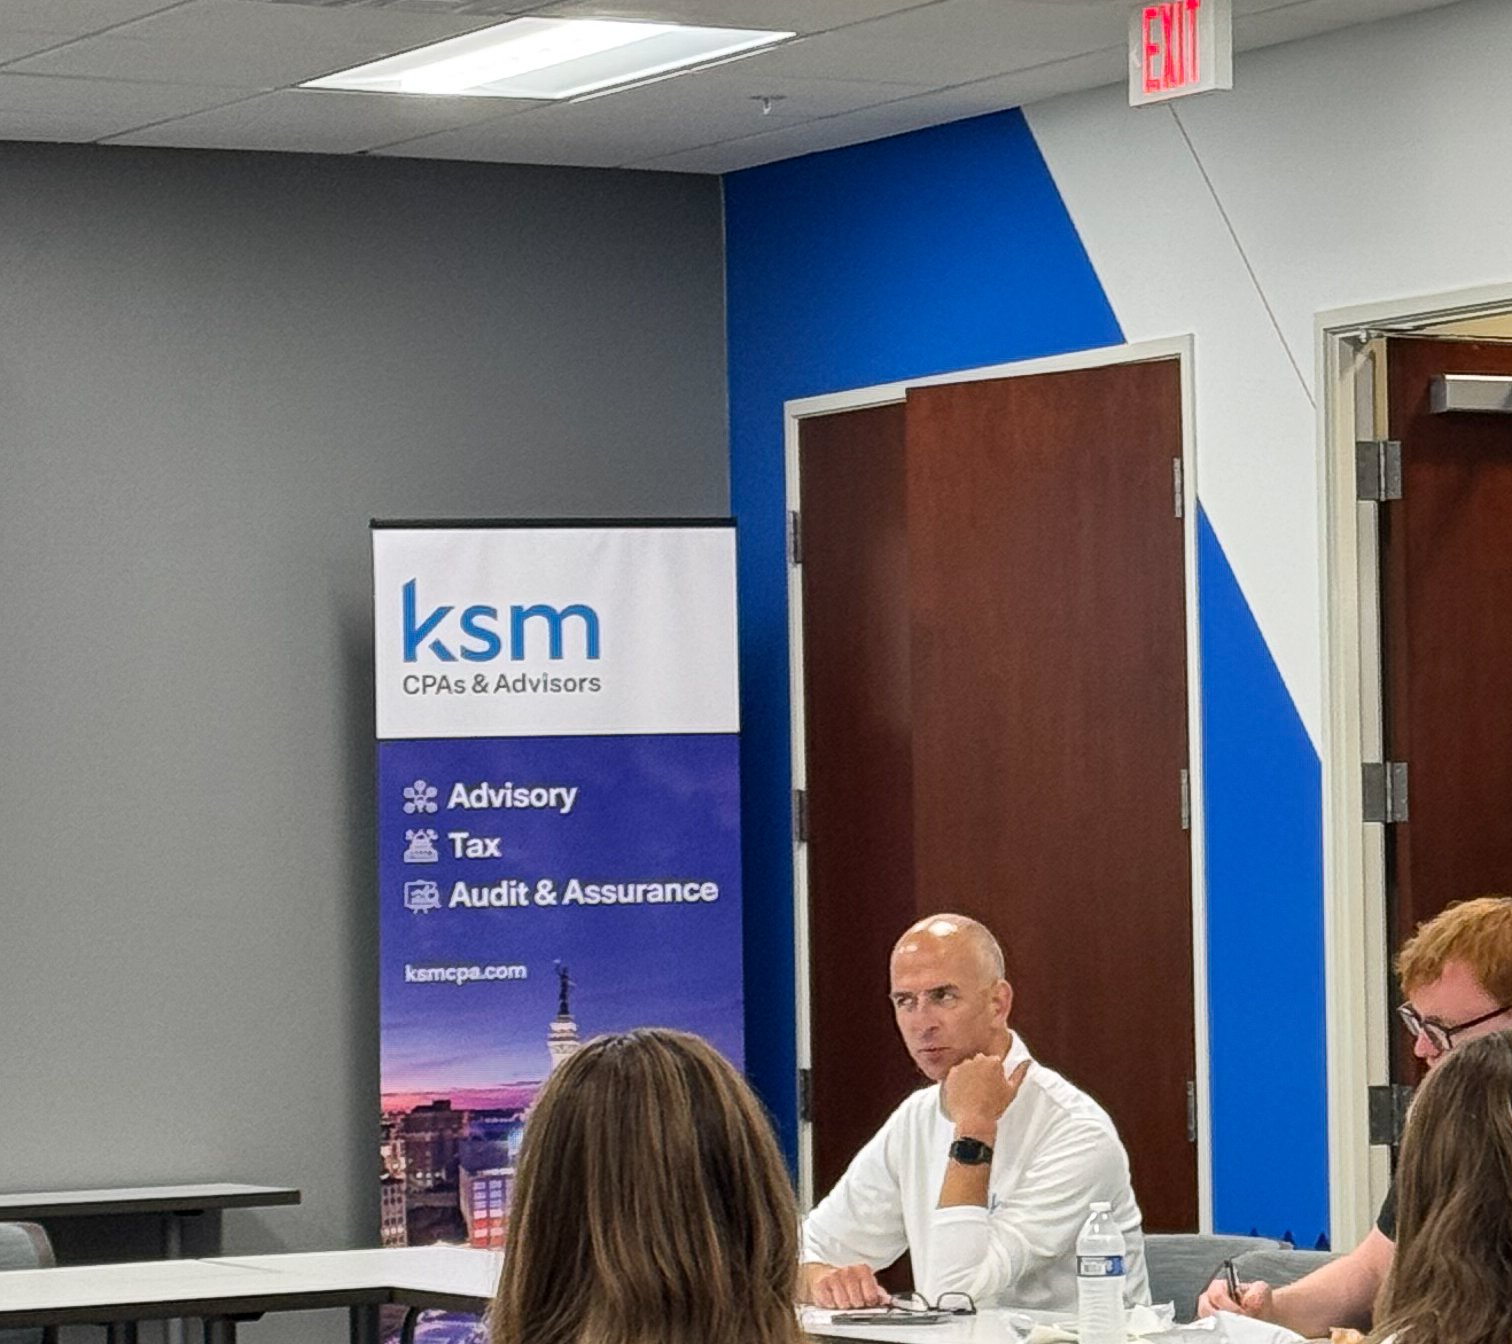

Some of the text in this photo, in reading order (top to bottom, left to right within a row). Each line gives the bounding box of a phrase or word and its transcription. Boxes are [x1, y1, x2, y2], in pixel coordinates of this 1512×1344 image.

[402, 578, 600, 662] ksm
[402, 672, 602, 695] CPAs & Advisors
[447, 783, 577, 813] Advisory
[448, 833, 502, 858] Tax
[449, 879, 718, 907] Audit & Assurance
[405, 963, 527, 986] ksmcpa.com
